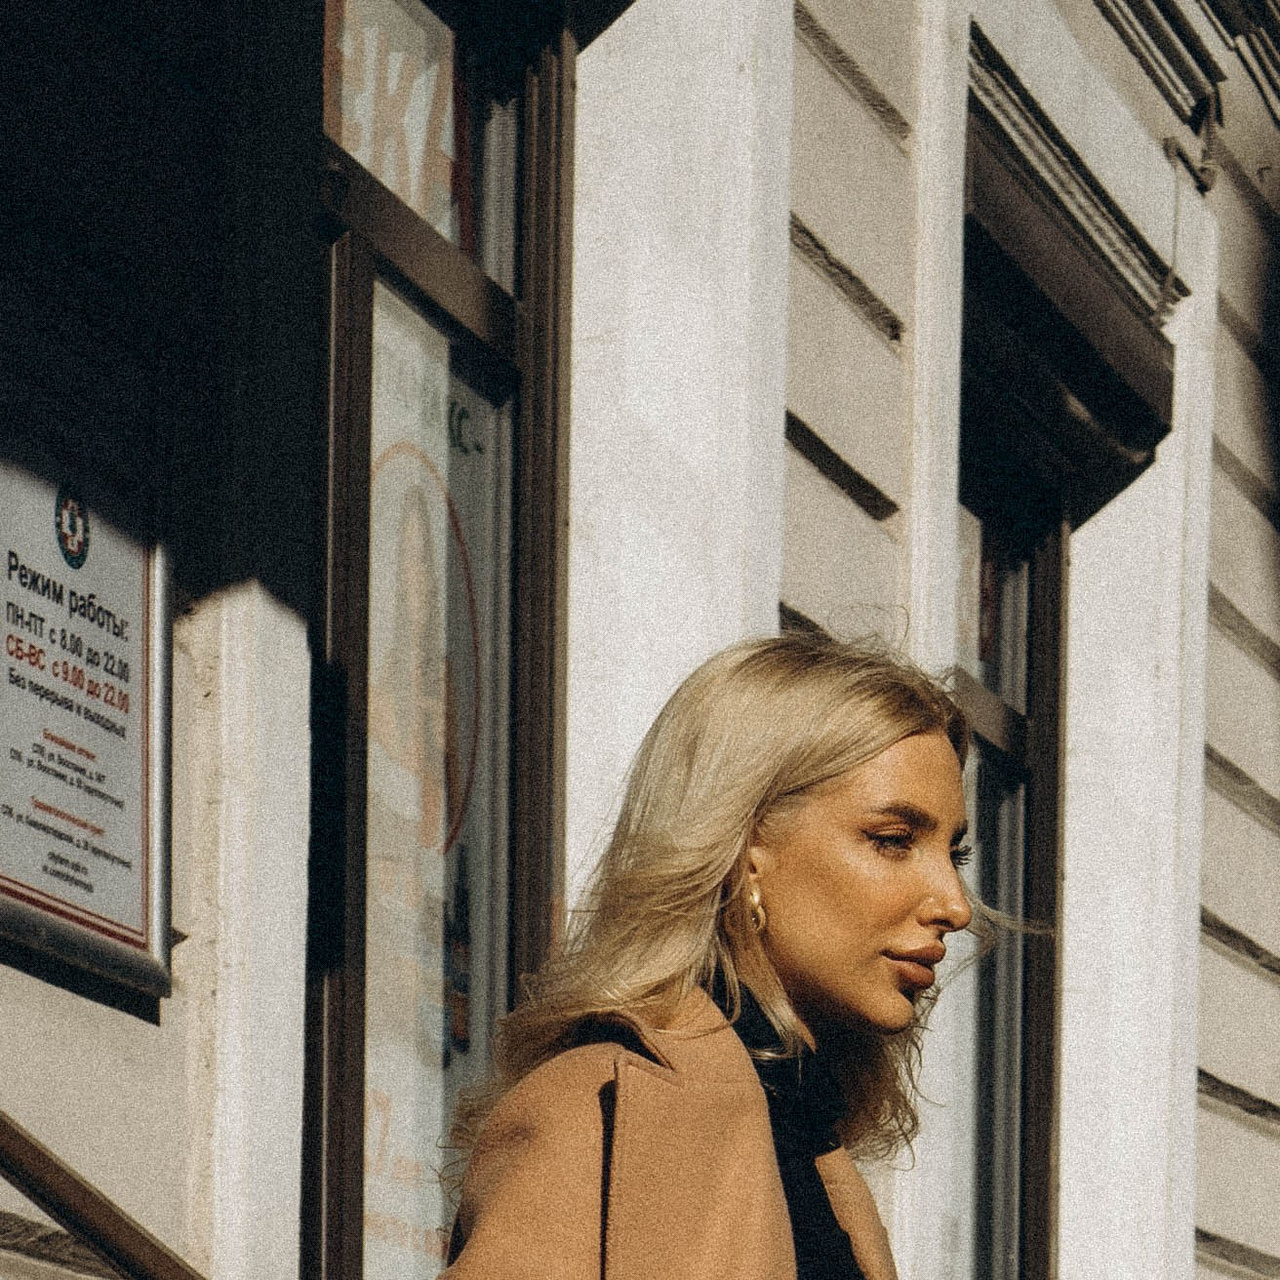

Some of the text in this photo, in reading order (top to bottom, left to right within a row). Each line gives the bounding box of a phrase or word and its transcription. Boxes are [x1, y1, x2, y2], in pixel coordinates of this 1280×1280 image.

[7, 550, 129, 642] Режим работы:
[5, 633, 46, 672] СБ-ВС
[52, 659, 59, 679] с
[86, 678, 101, 700] до
[6, 600, 45, 639] ПН-ПТ
[49, 627, 56, 645] с
[86, 646, 100, 668] до
